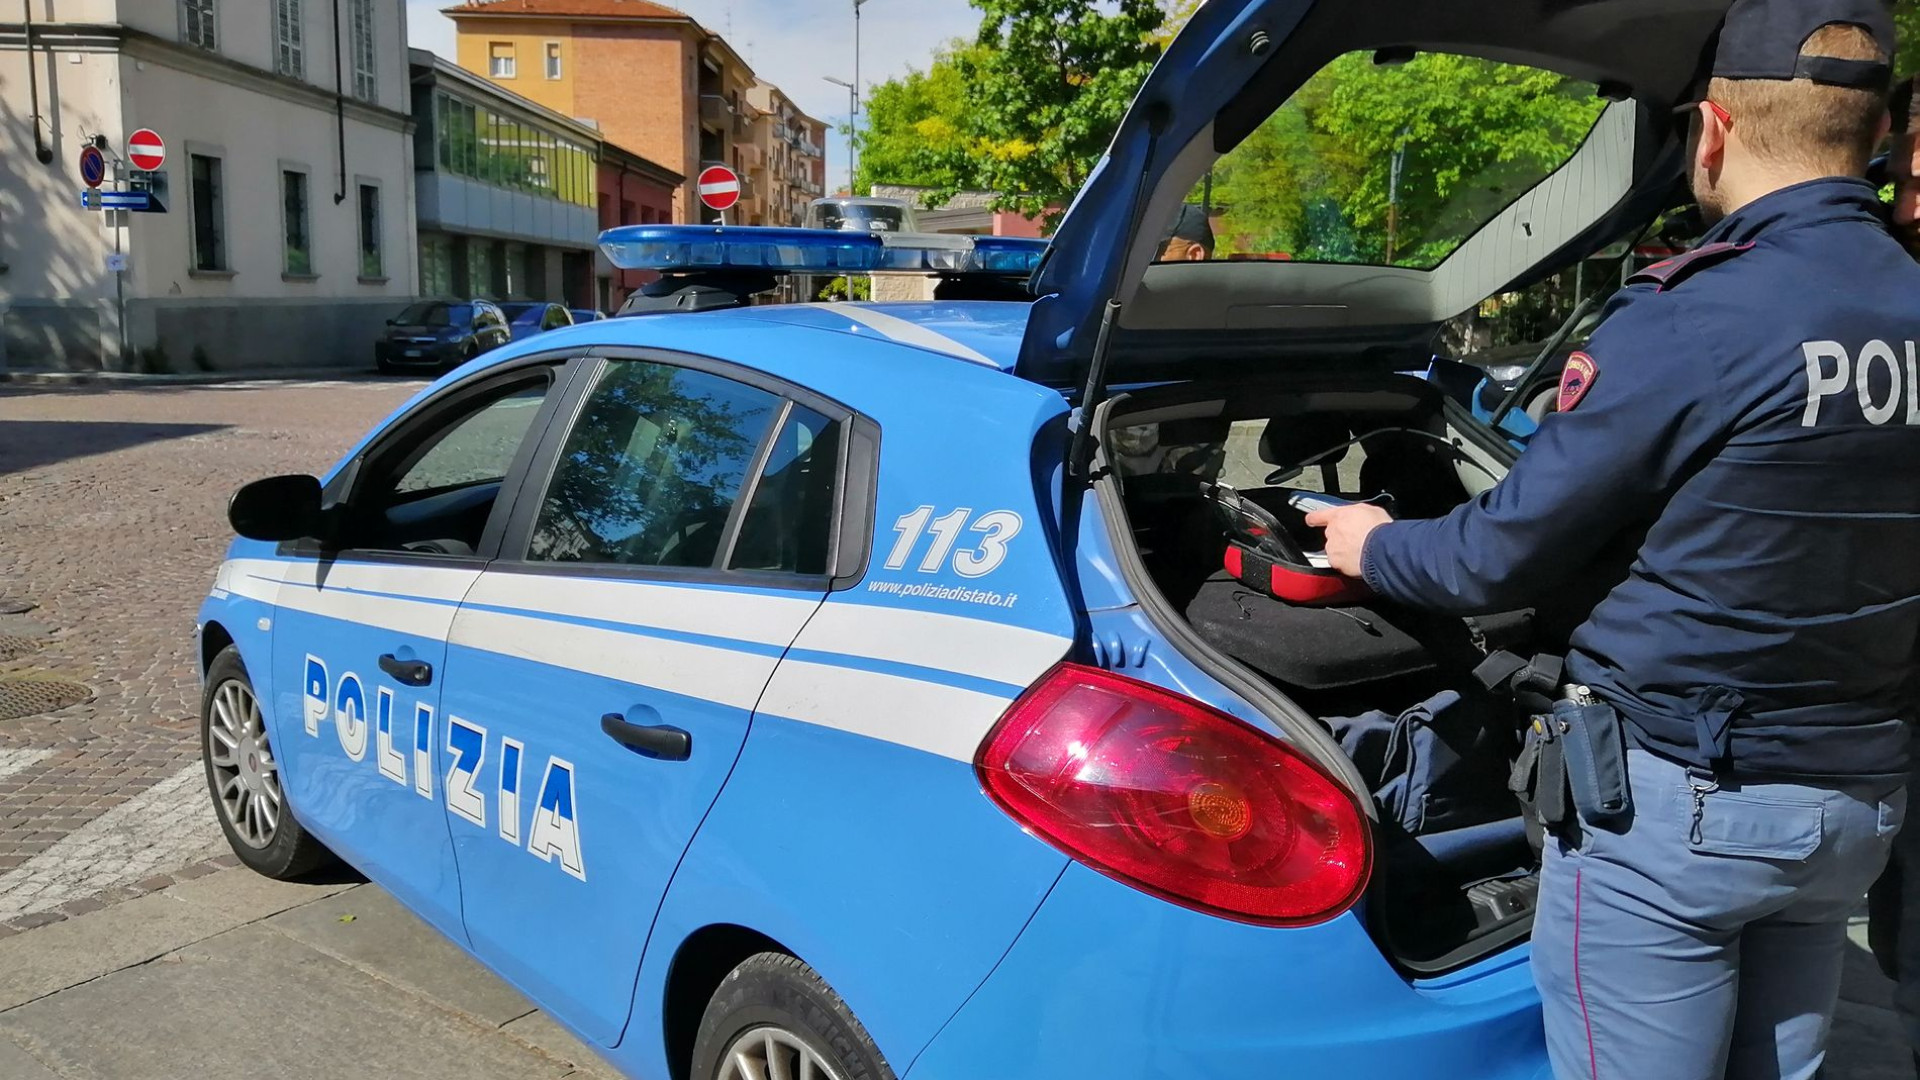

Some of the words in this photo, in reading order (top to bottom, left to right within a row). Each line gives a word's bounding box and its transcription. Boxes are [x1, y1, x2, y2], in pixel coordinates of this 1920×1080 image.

[883, 504, 1023, 579] 113
[867, 580, 1018, 608] www.poliziadistato.it
[303, 652, 587, 882] POLIZIA
